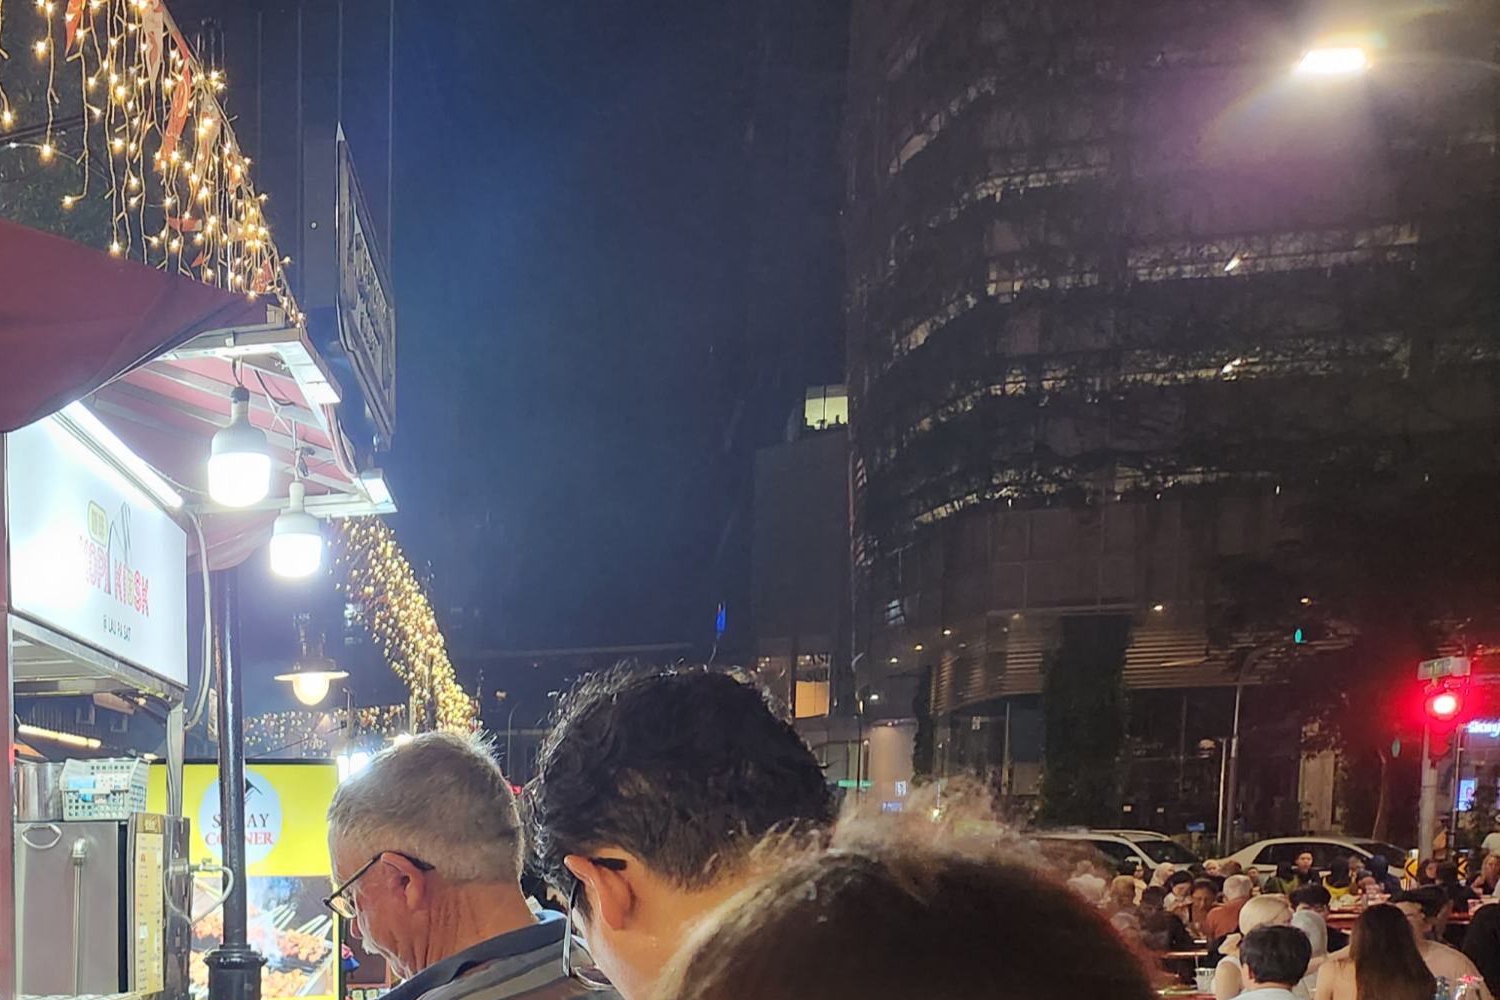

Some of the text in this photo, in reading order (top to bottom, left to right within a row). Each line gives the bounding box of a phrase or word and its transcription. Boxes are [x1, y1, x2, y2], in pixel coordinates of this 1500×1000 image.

[114, 557, 149, 618] KIOSK
[212, 813, 270, 829] SAY
[205, 831, 275, 846] CNER
